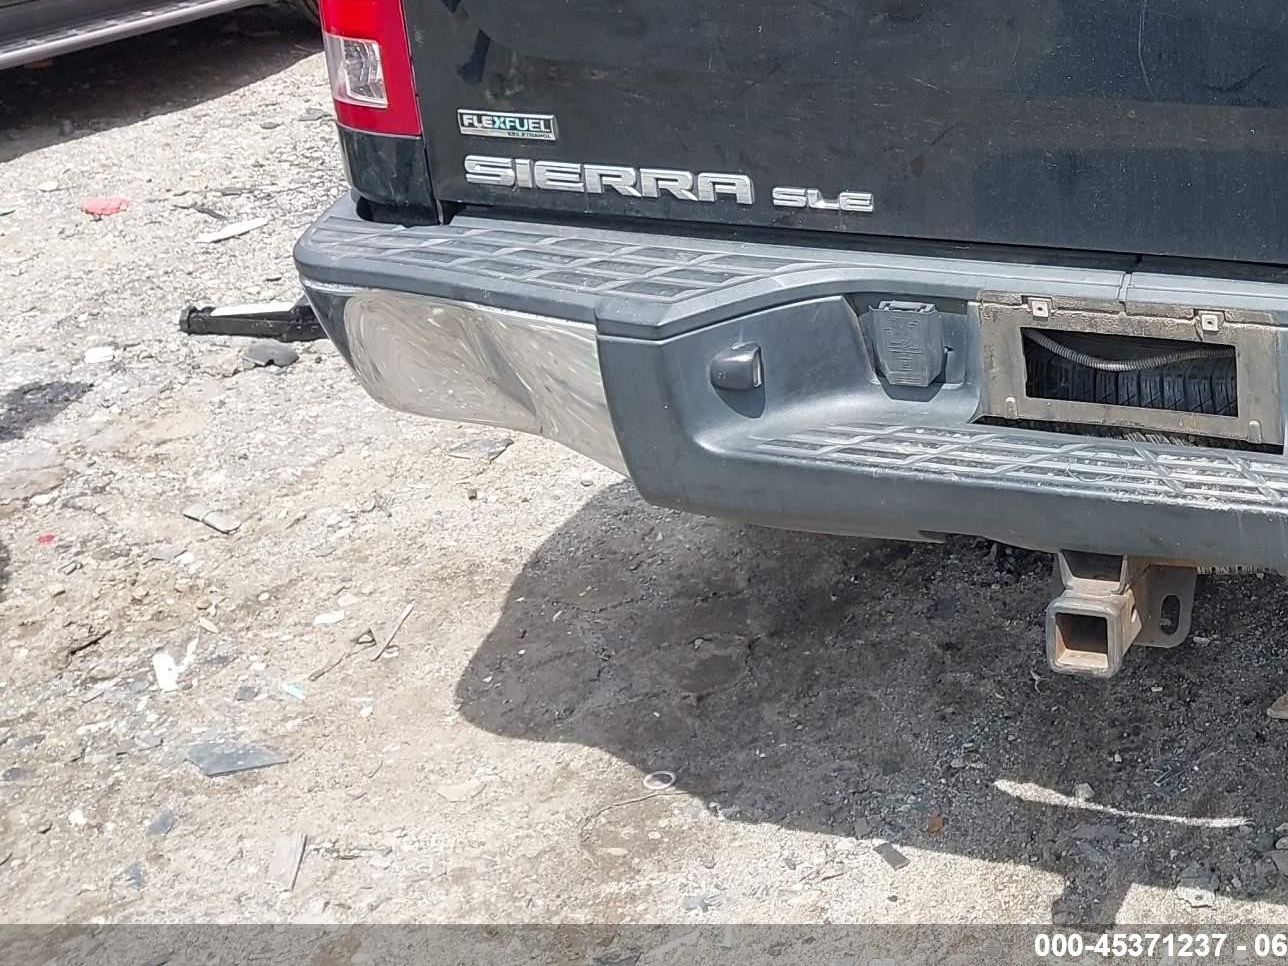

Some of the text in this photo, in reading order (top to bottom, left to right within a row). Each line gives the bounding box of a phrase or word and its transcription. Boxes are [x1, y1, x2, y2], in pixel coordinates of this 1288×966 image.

[462, 114, 551, 132] FLEXFUEL
[465, 154, 875, 213] SIERRA SLE
